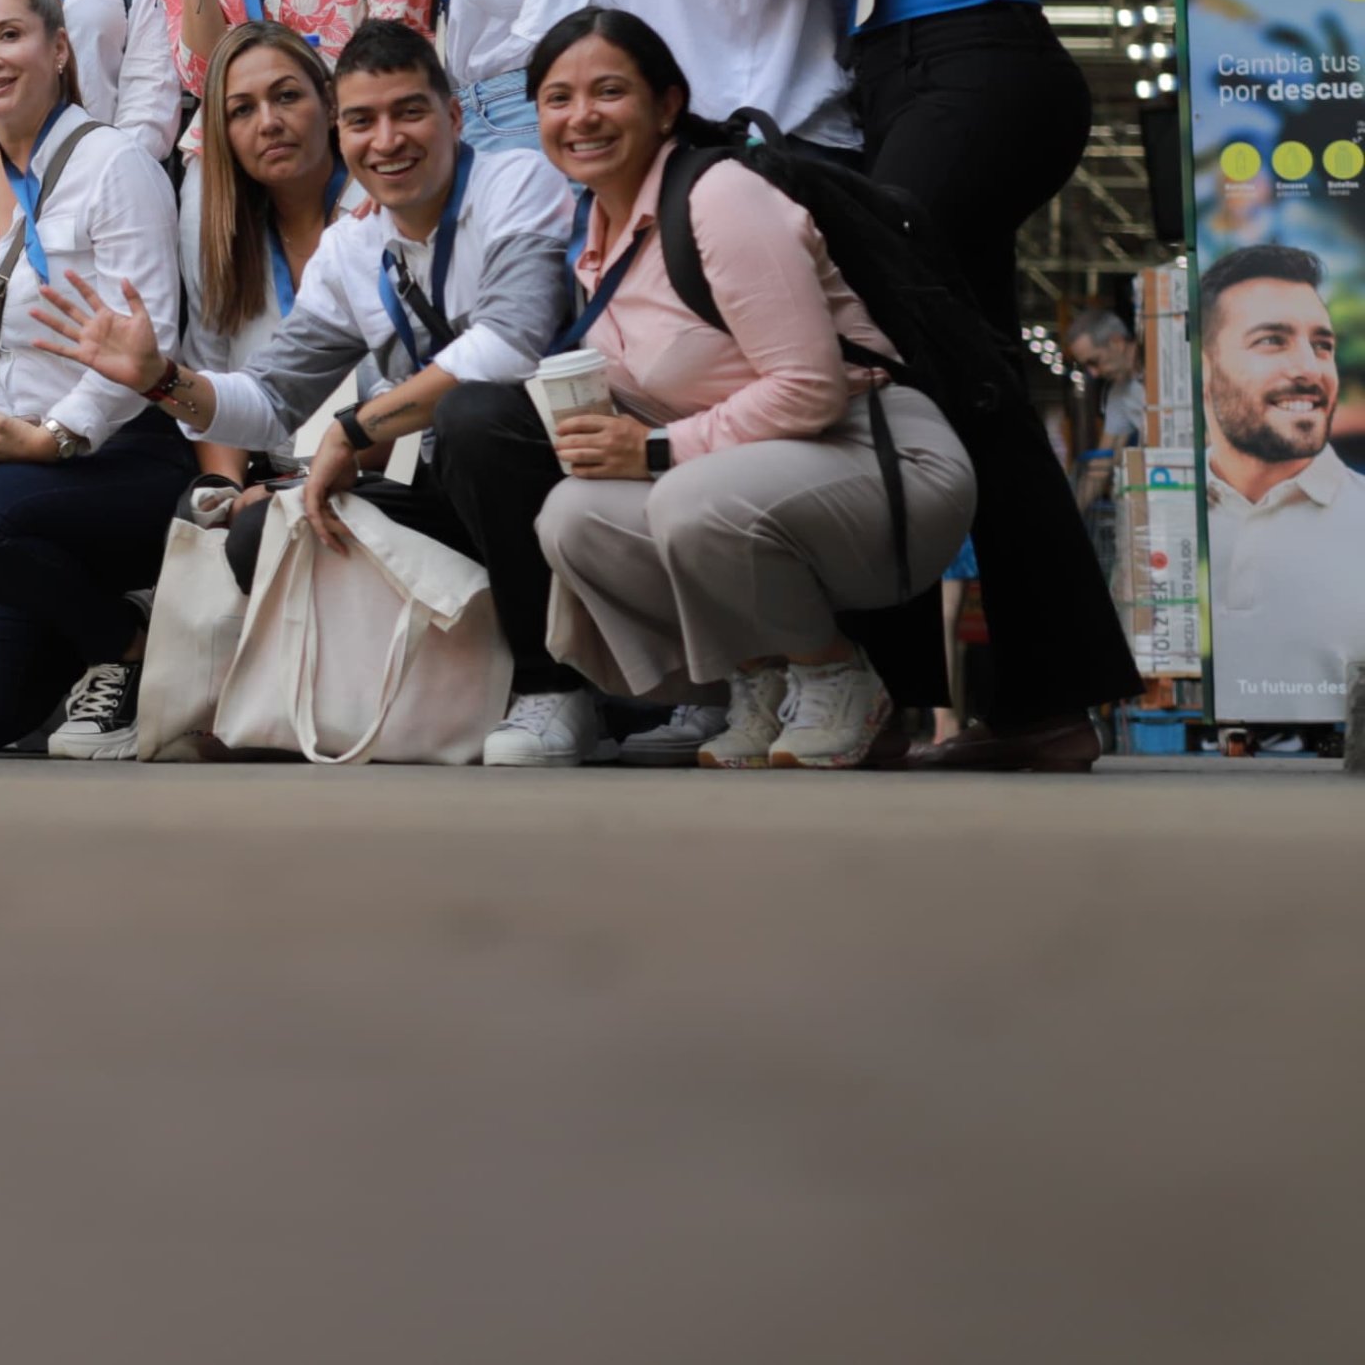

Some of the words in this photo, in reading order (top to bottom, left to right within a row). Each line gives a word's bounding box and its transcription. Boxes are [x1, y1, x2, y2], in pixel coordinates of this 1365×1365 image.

[1218, 53, 1313, 76] Cambia
[1321, 54, 1361, 73] tus
[1220, 85, 1261, 106] por
[1238, 679, 1258, 694] Tu
[1262, 679, 1313, 694] futuro
